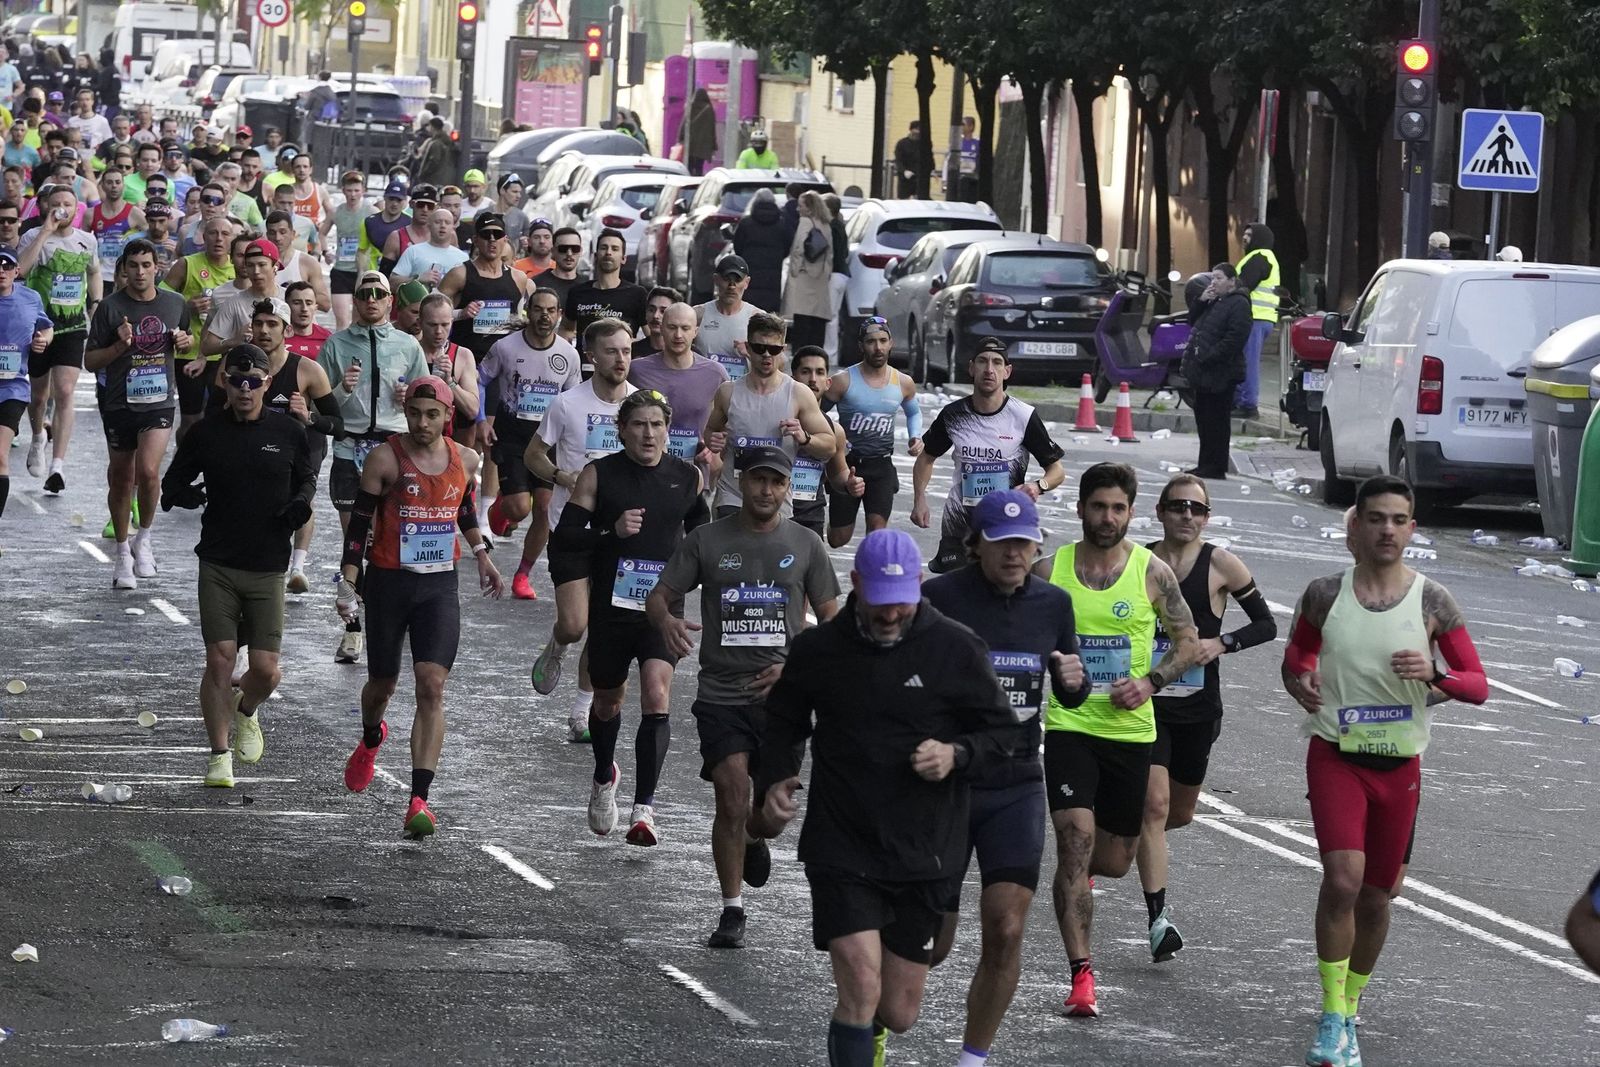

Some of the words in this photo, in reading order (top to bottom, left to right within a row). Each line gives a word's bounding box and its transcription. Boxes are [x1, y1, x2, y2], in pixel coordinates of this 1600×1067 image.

[263, 4, 283, 16] 30
[577, 303, 602, 312] Sports
[1026, 342, 1052, 354] 4249
[140, 367, 162, 375] ZURICH
[133, 386, 162, 395] HEIYMA
[1467, 409, 1500, 422] 9177
[1503, 411, 1528, 424] MFY
[670, 429, 695, 437] ZURICH
[749, 439, 777, 448] ZURICH
[961, 446, 1002, 459] RULISA
[795, 459, 820, 468] ZURICH
[975, 464, 1003, 472] ZURICH
[421, 524, 451, 533] ZURICH
[421, 540, 438, 548] 6557
[413, 549, 444, 562] JAIME
[637, 563, 665, 572] ZURIC
[636, 578, 654, 587] 5502
[743, 591, 780, 600] ZURICH
[744, 608, 764, 617] 4920
[721, 619, 786, 633] MUSTAPHA
[1085, 638, 1123, 647] ZURICH
[993, 656, 1034, 667] ZURICH
[1086, 656, 1105, 665] 9471
[998, 676, 1015, 688] 731
[1363, 709, 1405, 720] ZURICH
[1357, 742, 1400, 755] NEIRA
